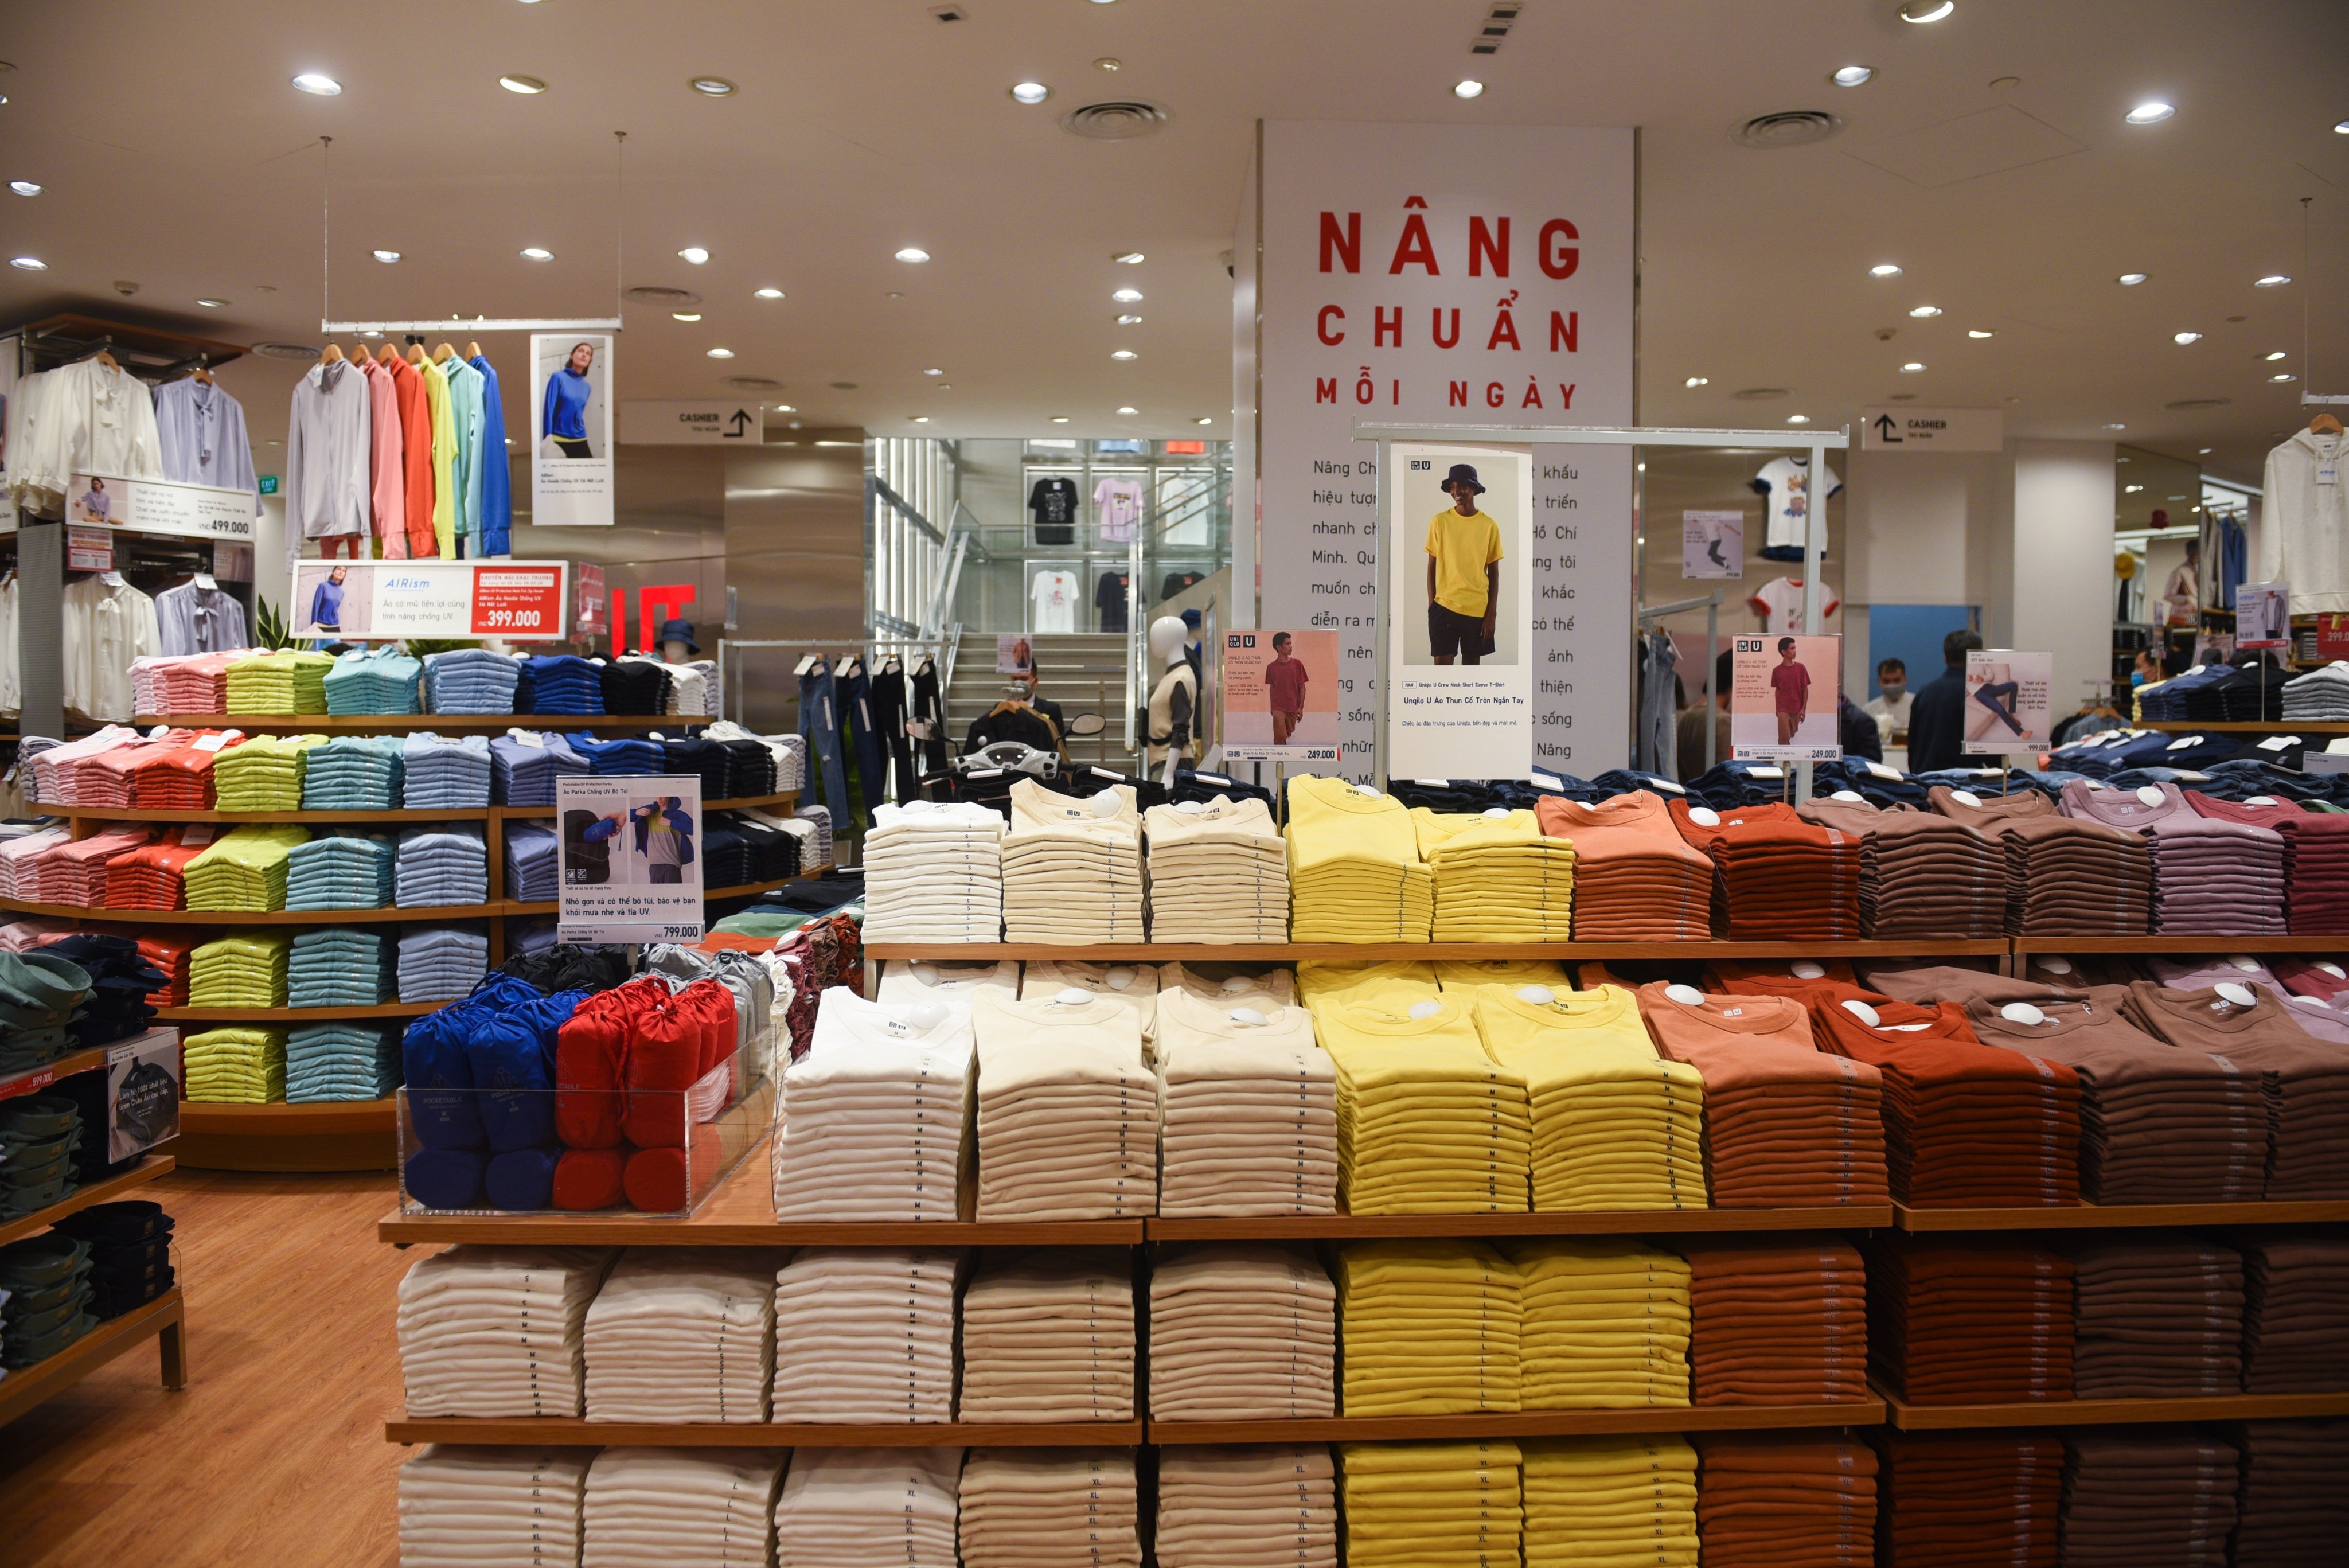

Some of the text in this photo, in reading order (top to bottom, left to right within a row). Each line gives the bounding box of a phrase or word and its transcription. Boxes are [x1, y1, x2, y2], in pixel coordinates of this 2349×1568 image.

[1319, 195, 1579, 280] NÂNG
[1317, 289, 1578, 352] CHUẨN
[1316, 366, 1576, 410] MỖI NGÀY
[679, 413, 719, 422] CASHIER
[1908, 420, 1947, 429] CASHIER
[1314, 460, 1578, 479] Nâng Ch khẩu
[1314, 490, 1342, 506] hiệu
[1546, 494, 1577, 509] triển
[211, 520, 248, 534] 499.000
[1313, 521, 1355, 534] nhanh
[1556, 526, 1577, 539] Chí
[1313, 550, 1346, 563] Minh.
[1357, 550, 1375, 567] Qu
[1560, 555, 1576, 568] tôi
[385, 578, 429, 588] AIRism
[1312, 580, 1575, 599] muốn ch khắc
[487, 609, 541, 627] 399.000
[1311, 611, 1574, 631] diễn ra có thể
[1245, 637, 1253, 646] U
[2327, 632, 2349, 642] 399.0
[1753, 642, 1759, 651] U
[1348, 646, 1573, 662] nên ảnh
[1540, 680, 1572, 696] thiện
[1512, 697, 1524, 705] Tay
[1348, 706, 1572, 728] sốn sống
[1307, 750, 1335, 759] 249.000
[1537, 743, 1571, 759] Nâng
[1812, 750, 1836, 758] 249.000
[619, 896, 630, 904] thể
[672, 897, 680, 905] vệ
[683, 897, 695, 905] bạn
[602, 909, 614, 917] nhẹ
[664, 926, 698, 937] 799.000
[32, 1072, 53, 1087] 599.000
[138, 1085, 148, 1094] 100%
[149, 1081, 159, 1089] chất
[119, 1102, 130, 1111] linen
[131, 1098, 142, 1106] Châu
